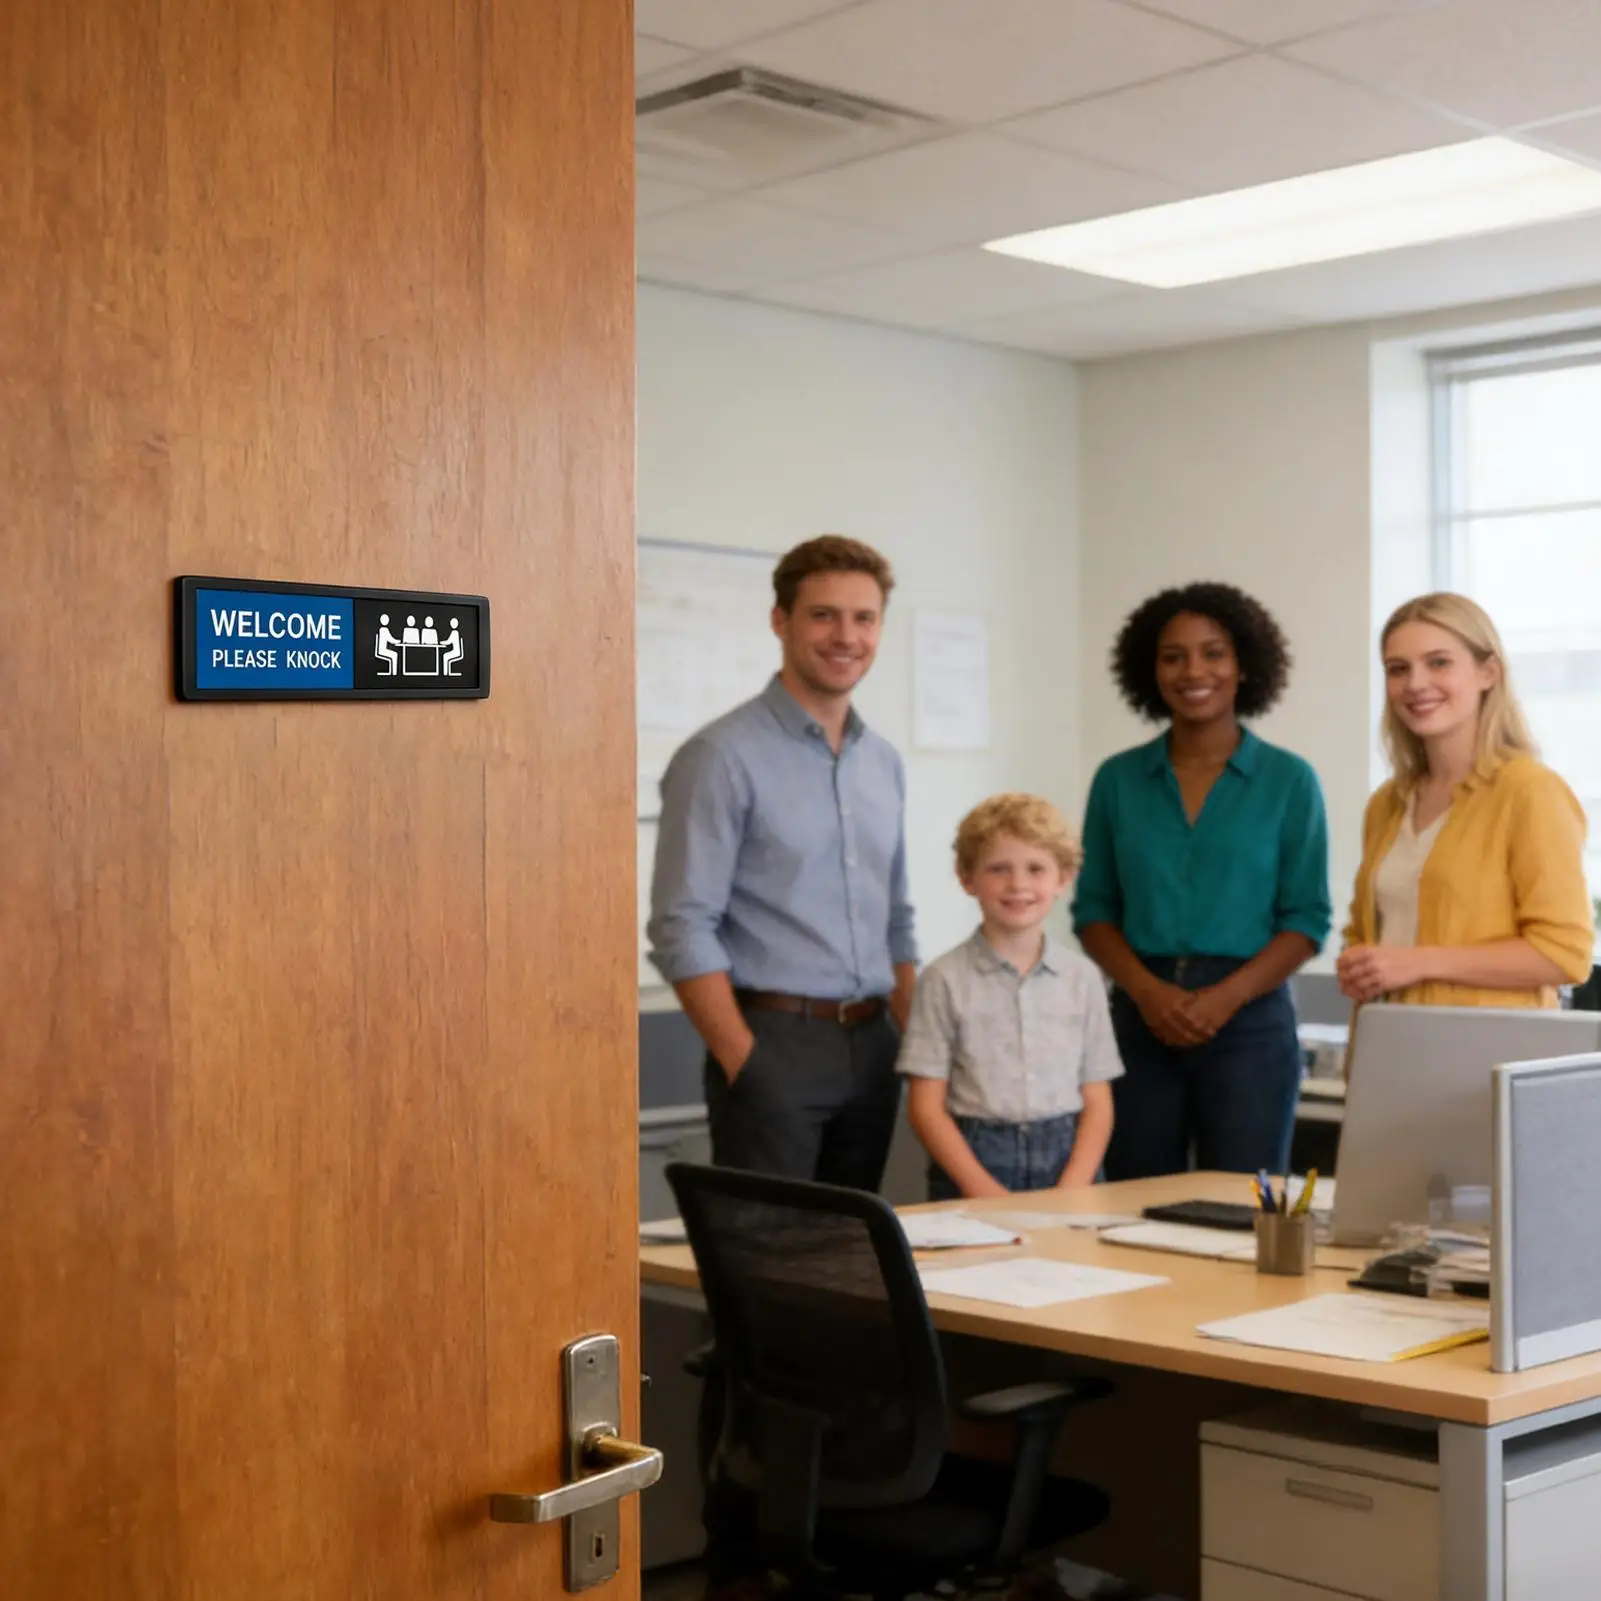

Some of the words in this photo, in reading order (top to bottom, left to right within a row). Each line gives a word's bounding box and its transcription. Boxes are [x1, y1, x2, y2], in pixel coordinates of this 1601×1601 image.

[210, 609, 342, 640] WELCOME
[212, 649, 277, 668] PLEASE
[286, 650, 341, 669] KNOCK
